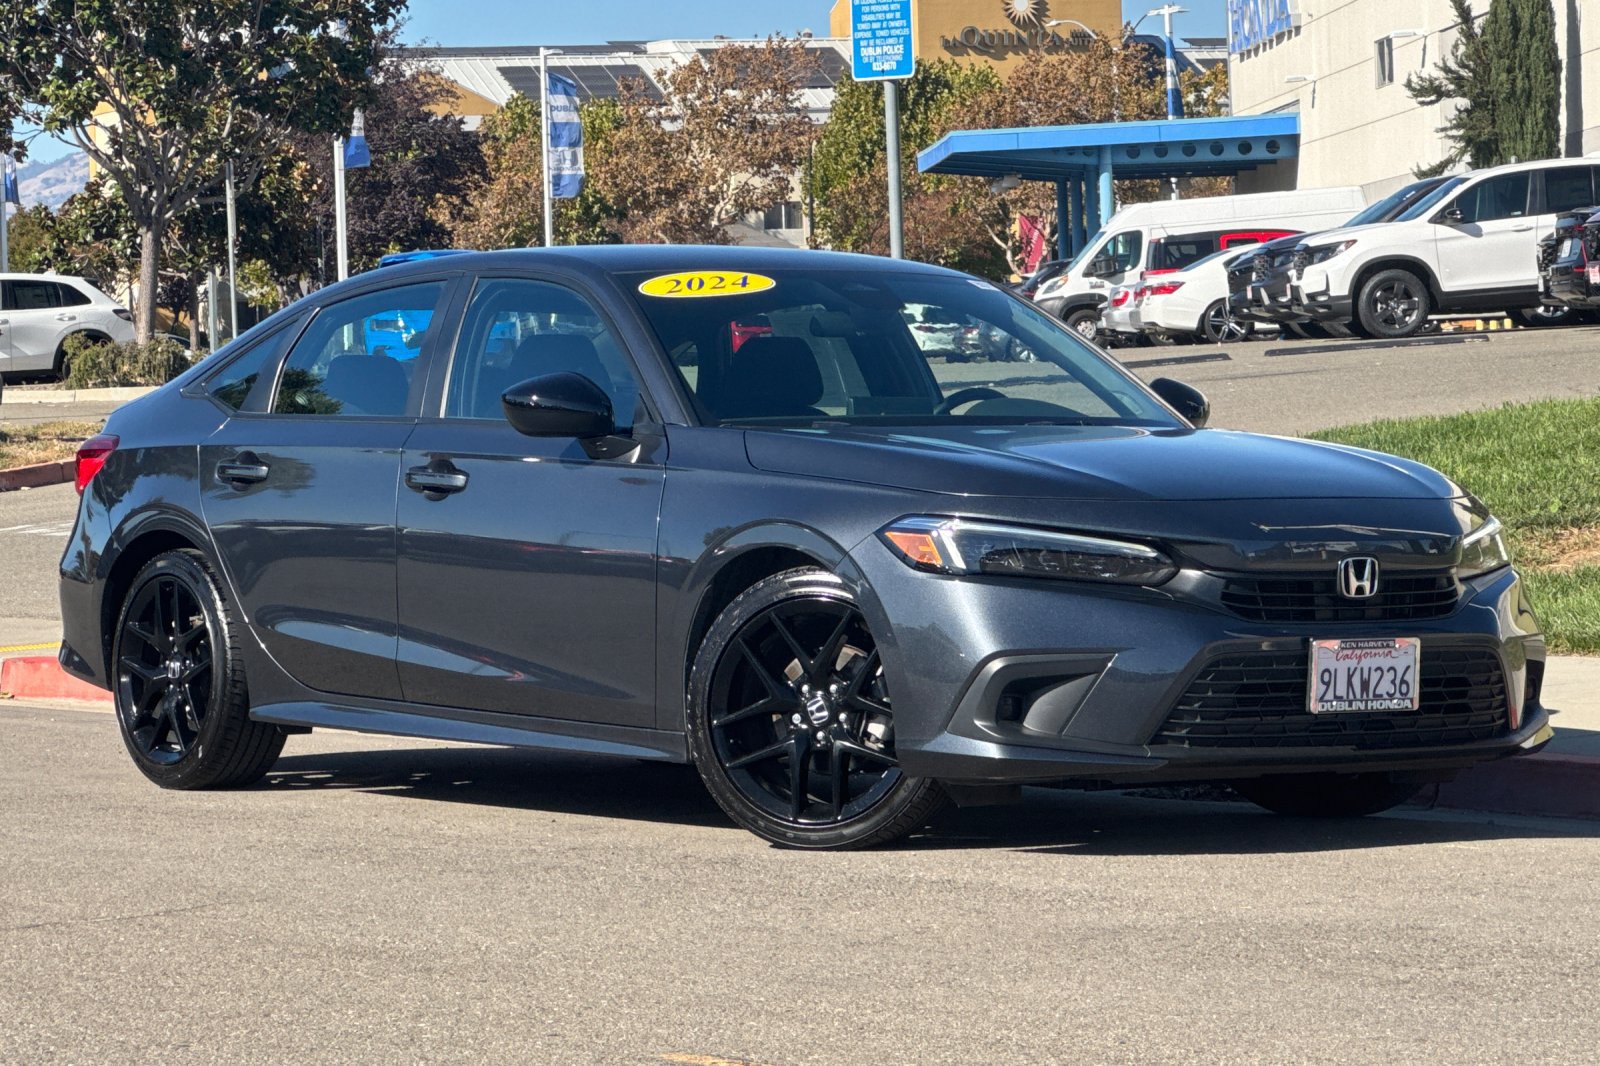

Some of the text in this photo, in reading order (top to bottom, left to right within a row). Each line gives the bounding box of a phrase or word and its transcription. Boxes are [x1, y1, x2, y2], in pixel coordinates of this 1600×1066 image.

[960, 26, 1061, 53] QUINTA
[860, 44, 904, 57] DUBLIN POLICE
[665, 275, 750, 294] 2024
[1340, 639, 1396, 648] KEN HARVEY'S
[1335, 648, 1400, 666] California
[1319, 665, 1411, 700] 9LKW236
[1318, 698, 1413, 712] DUBLIN HONDA
